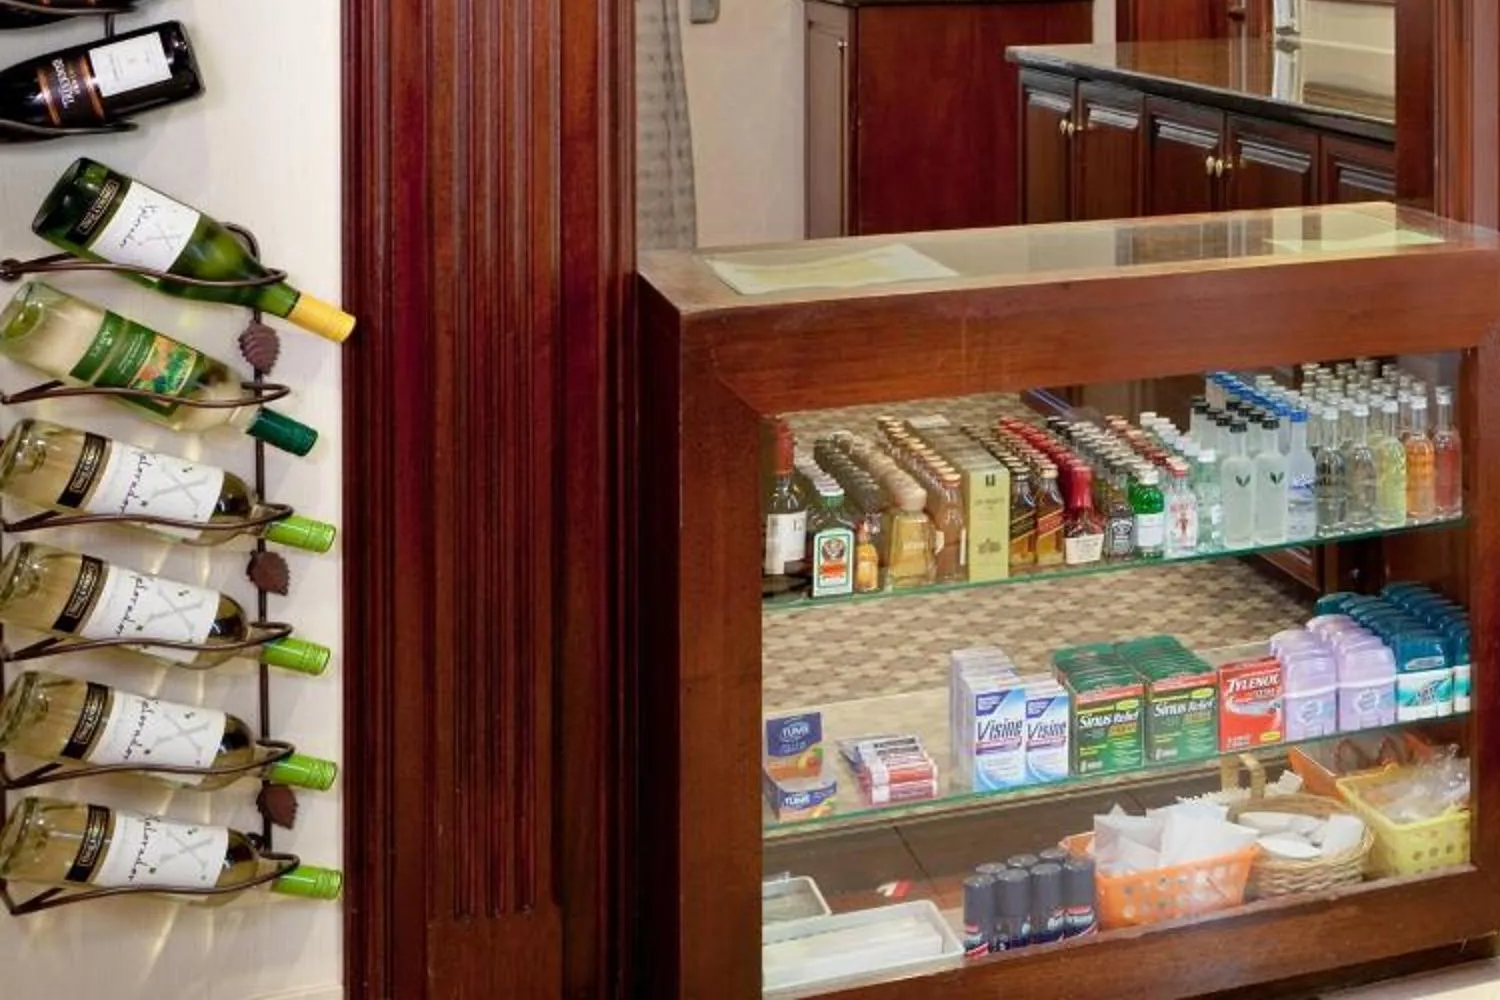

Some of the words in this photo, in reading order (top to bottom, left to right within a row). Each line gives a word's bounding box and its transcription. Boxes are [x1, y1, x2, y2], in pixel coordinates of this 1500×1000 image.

[1154, 701, 1186, 717] Sinus
[1080, 713, 1110, 729] Sinus
[978, 719, 1022, 741] Visine
[1028, 721, 1066, 740] Visine
